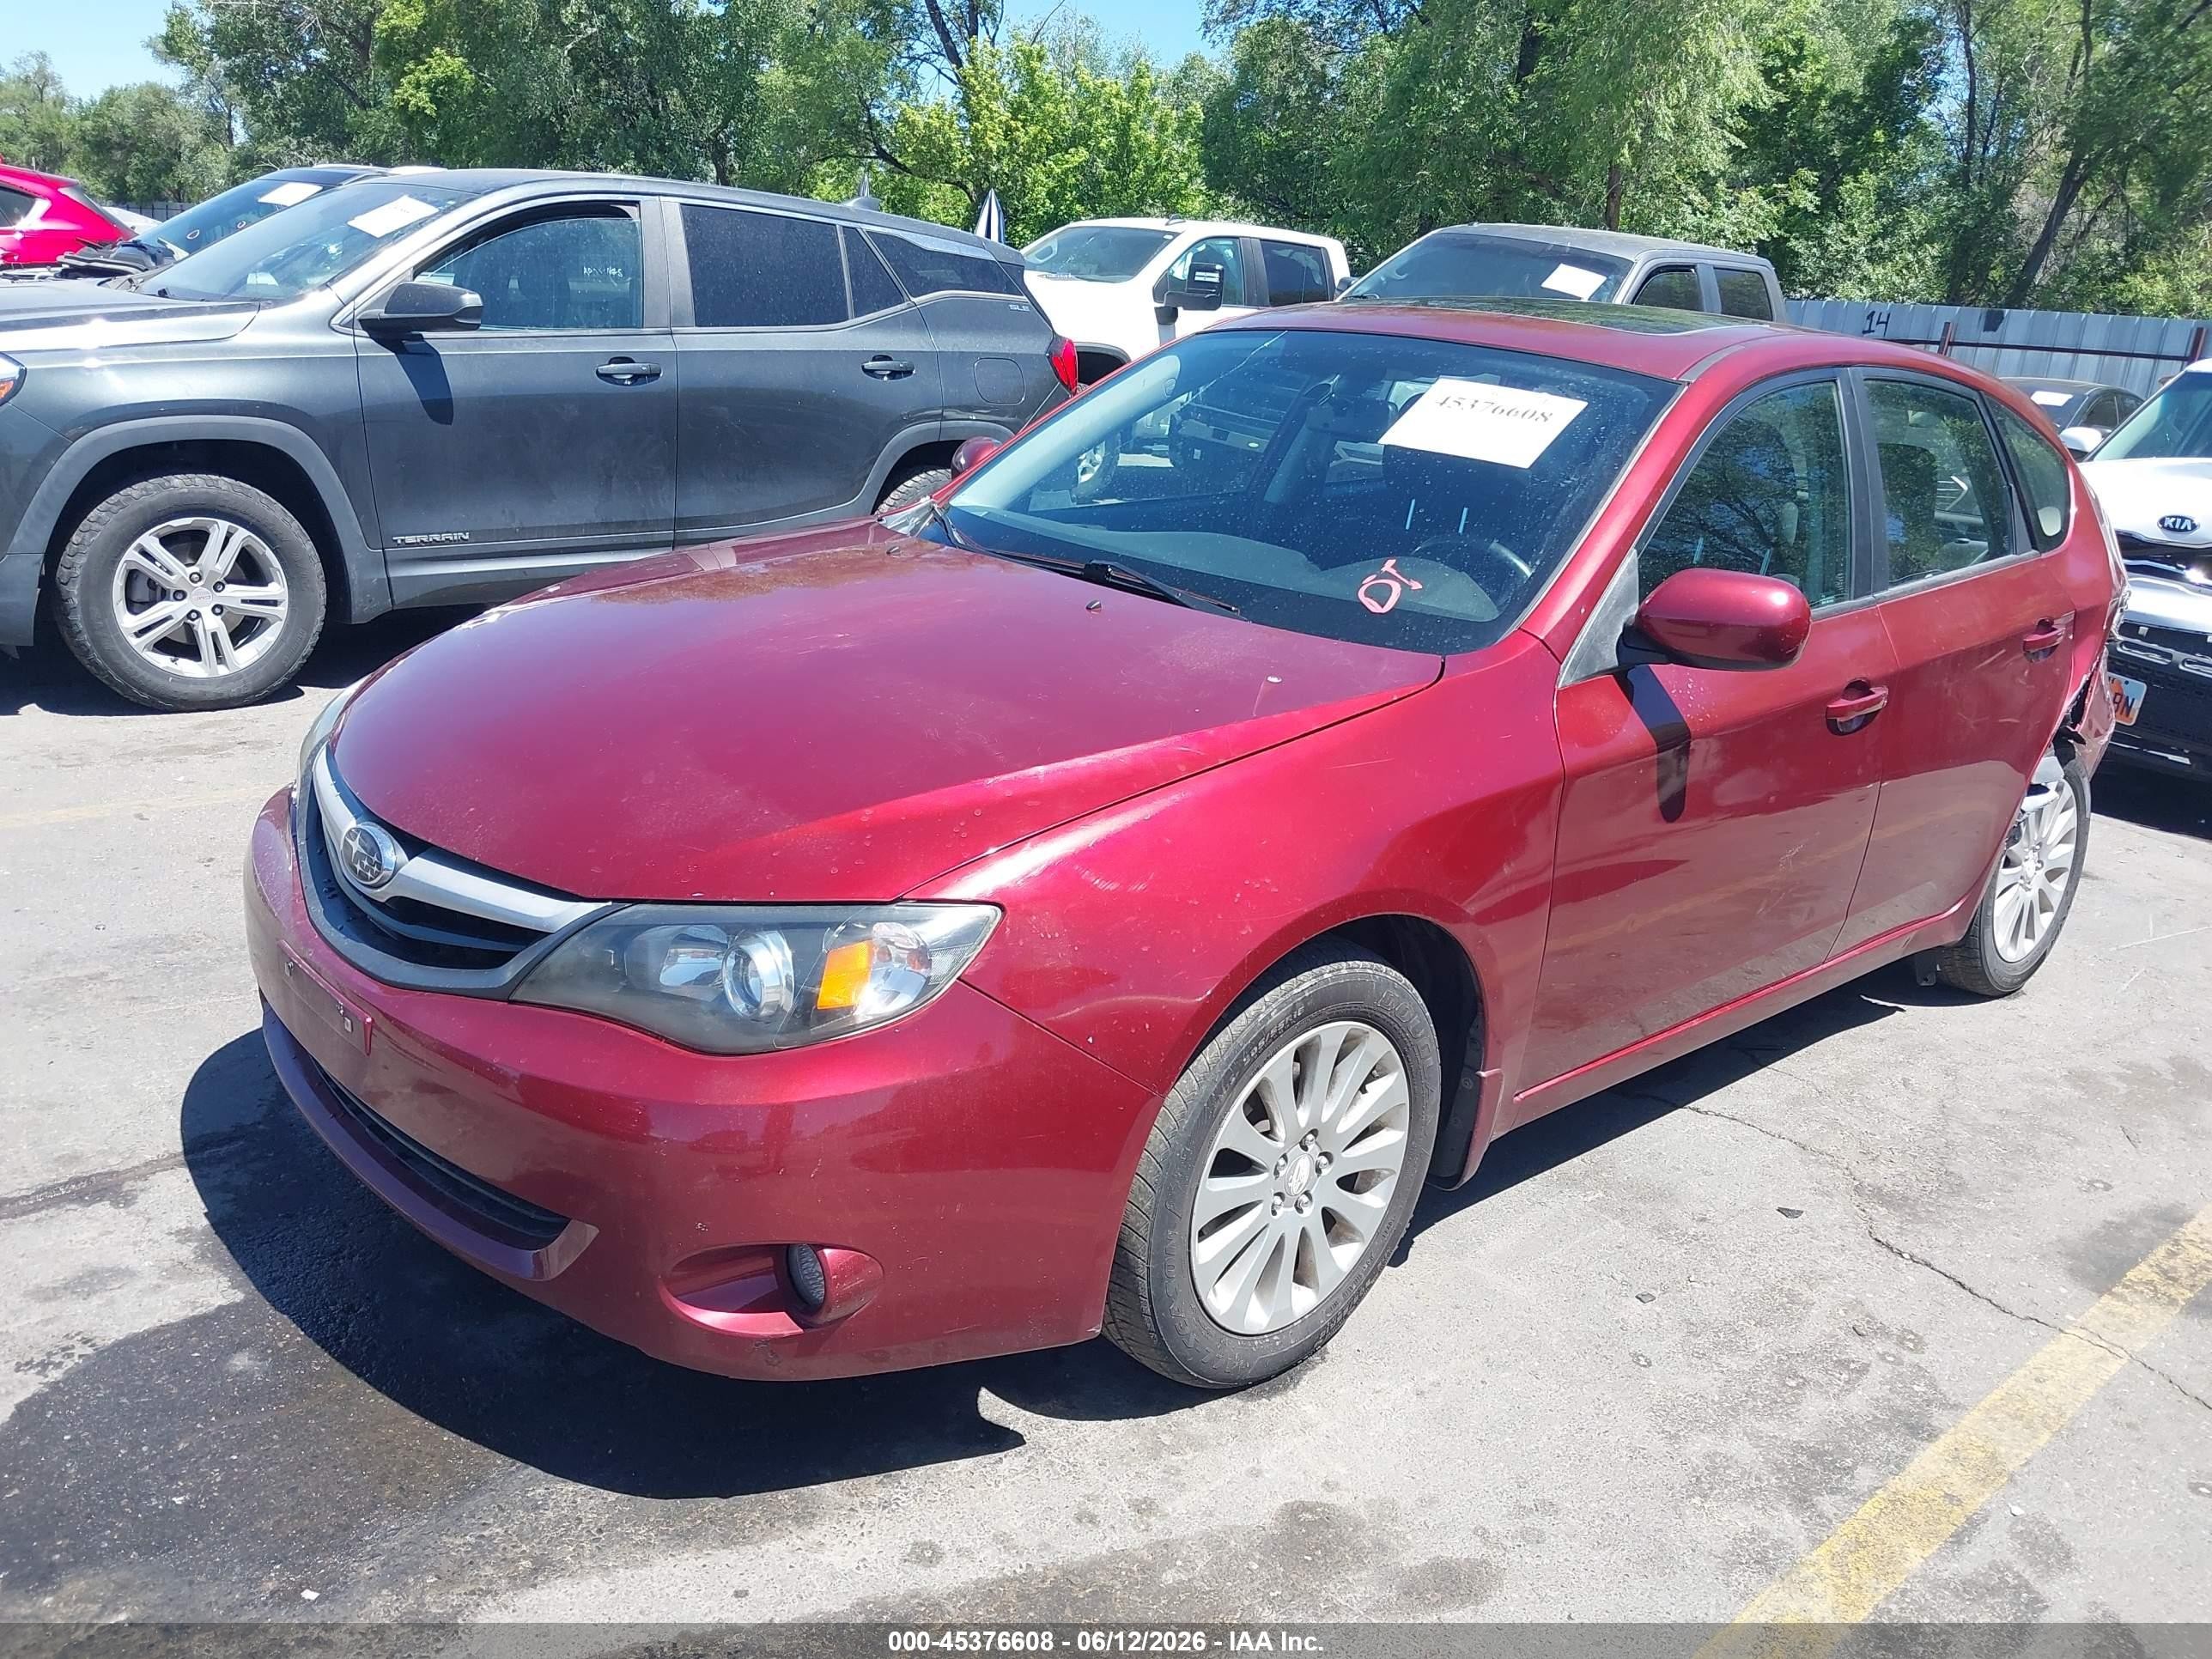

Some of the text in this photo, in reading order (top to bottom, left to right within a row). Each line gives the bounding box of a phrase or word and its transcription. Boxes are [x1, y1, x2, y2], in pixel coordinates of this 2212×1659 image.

[1862, 311, 1890, 337] 14
[1436, 395, 1553, 422] 45376608
[2164, 517, 2192, 531] KIA
[392, 532, 470, 544] TERRAIN
